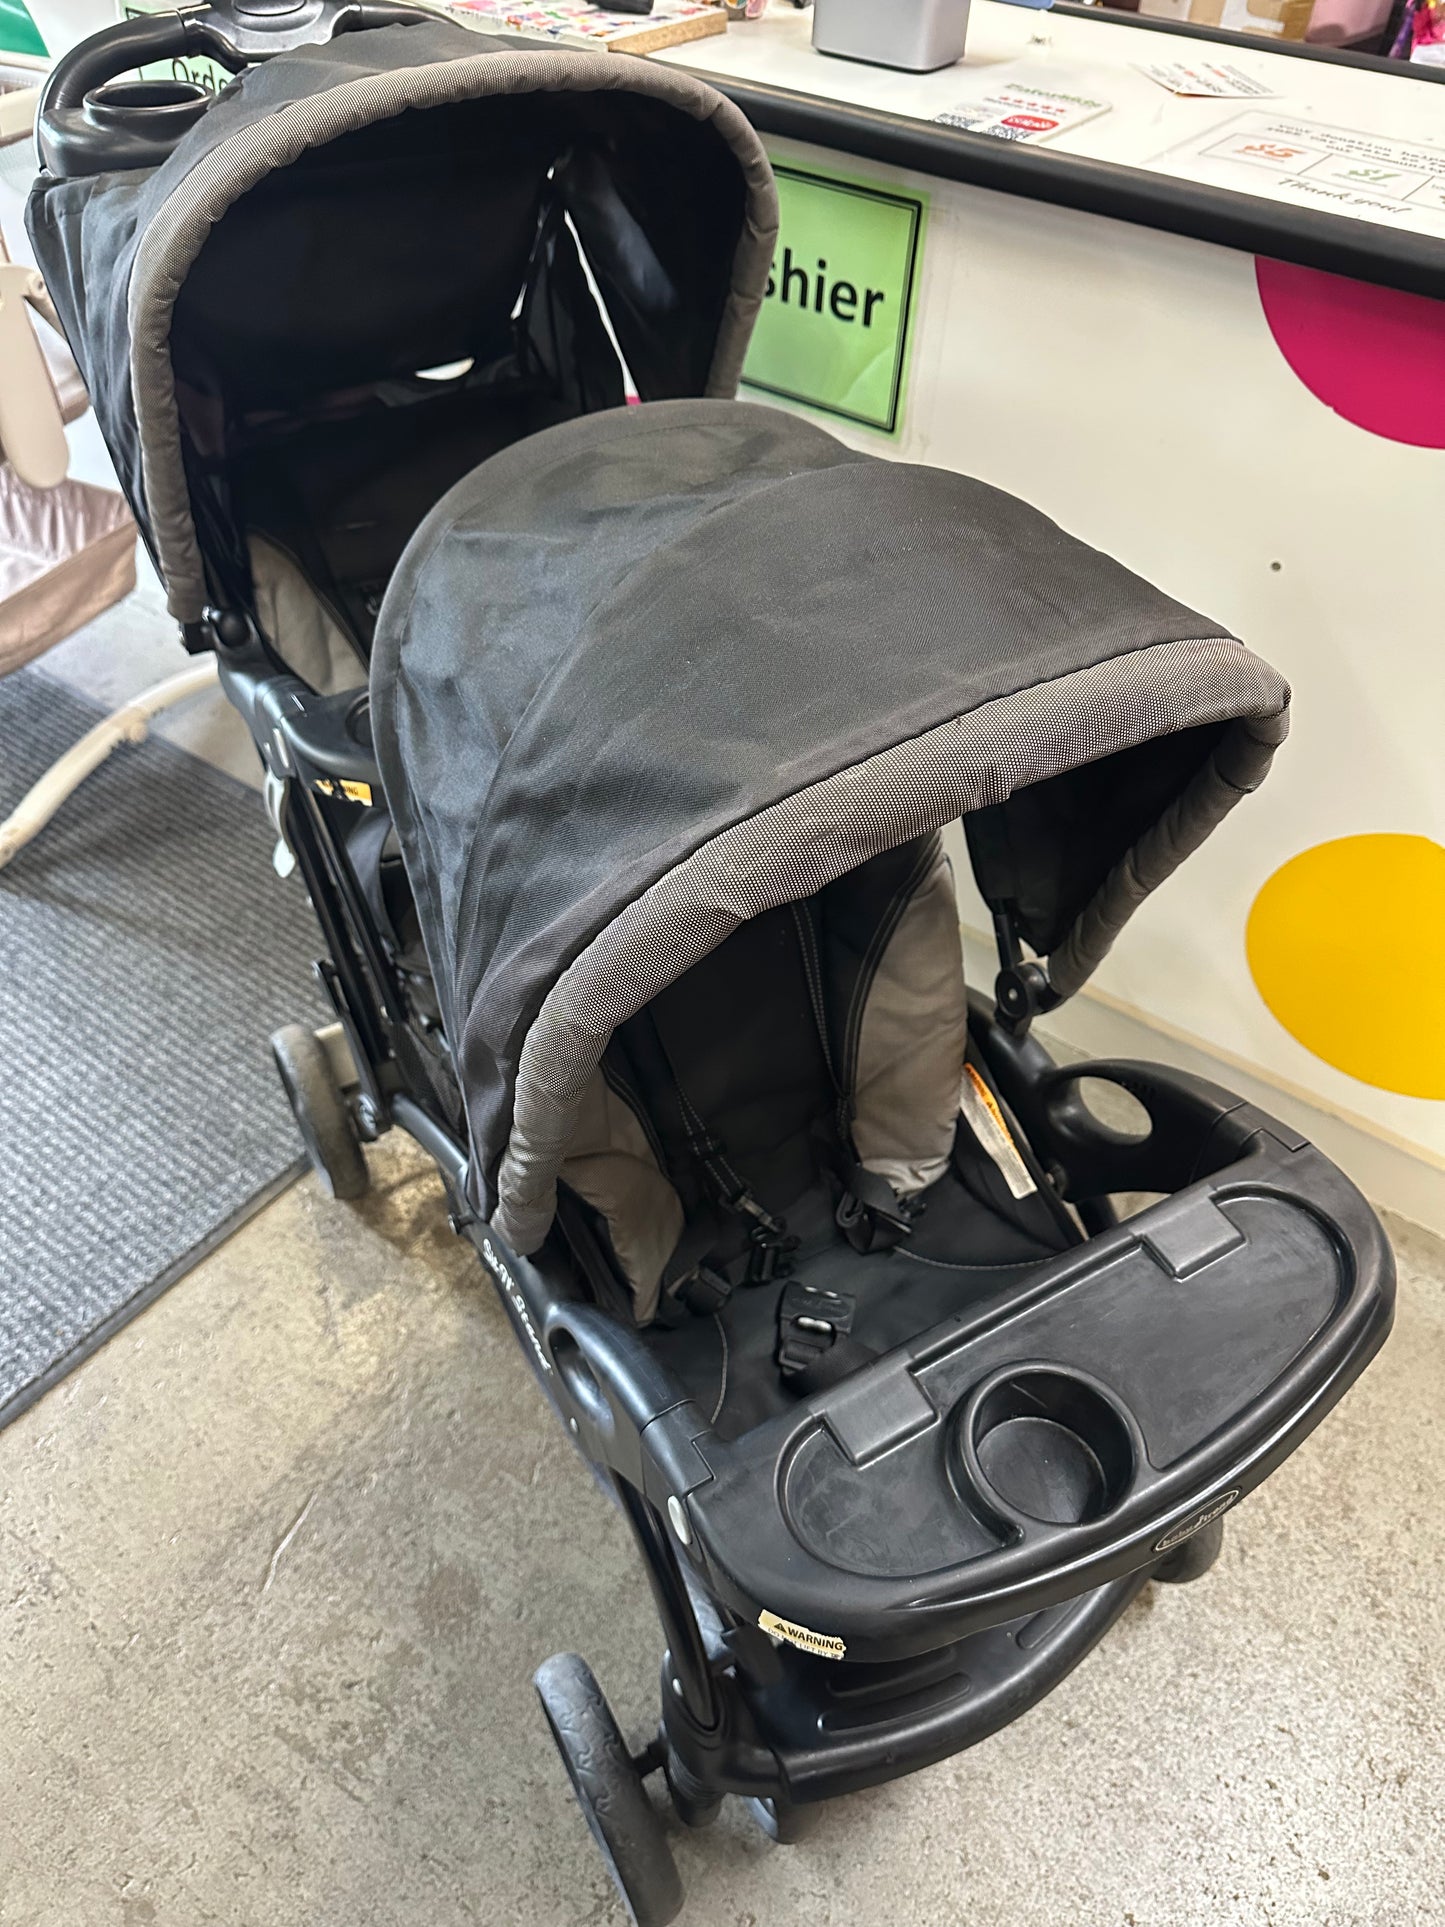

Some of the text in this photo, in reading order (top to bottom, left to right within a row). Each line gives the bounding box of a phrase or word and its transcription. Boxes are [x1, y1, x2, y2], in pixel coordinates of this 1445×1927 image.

[1244, 143, 1306, 159] $5
[1348, 168, 1402, 182] $1
[1278, 177, 1351, 201] Thank
[787, 1626, 843, 1651] WARNING
